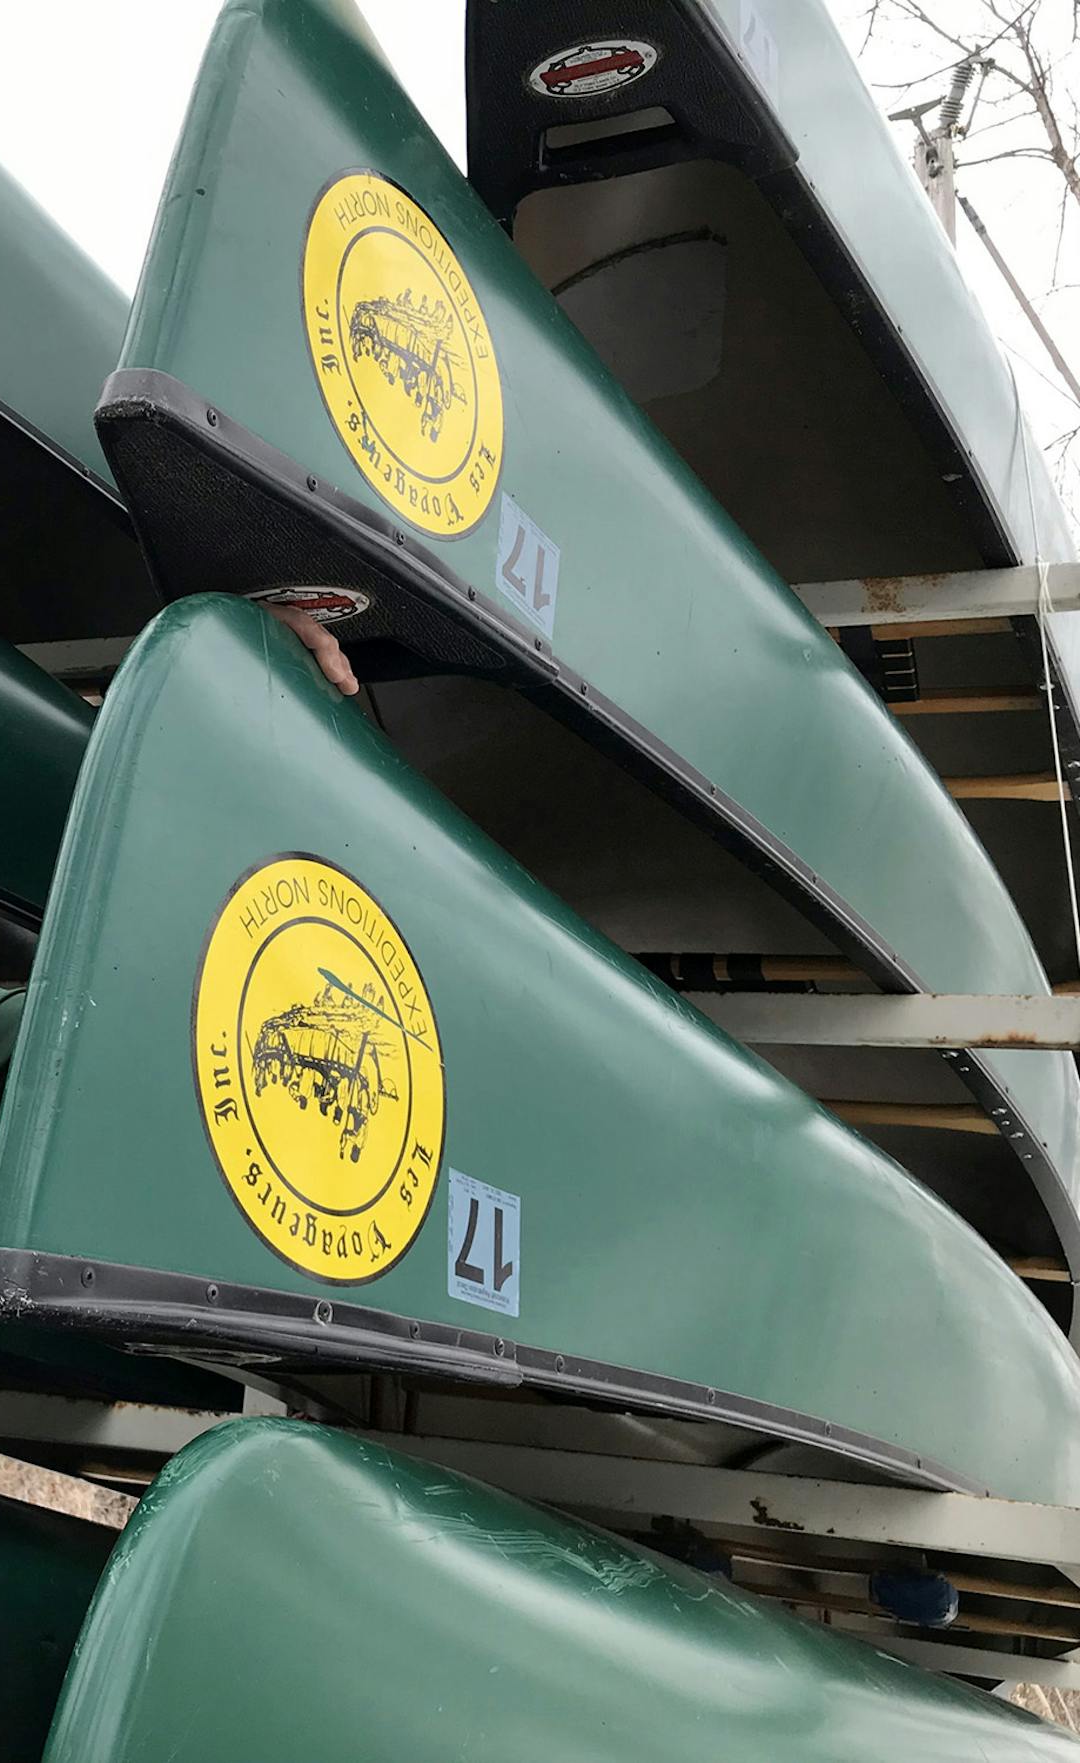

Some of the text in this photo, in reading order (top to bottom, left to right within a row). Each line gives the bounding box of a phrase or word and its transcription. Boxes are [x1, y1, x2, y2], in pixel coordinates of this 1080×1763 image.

[333, 190, 490, 361] EXPEDITIONS NORTH
[314, 298, 343, 378] Inc.
[469, 438, 496, 495] Les
[502, 525, 550, 612] 17
[239, 875, 427, 1039] EXPEDITIONS NORTH
[208, 1029, 241, 1129] Inc.
[399, 1138, 434, 1208] Les
[455, 1198, 513, 1292] 17
